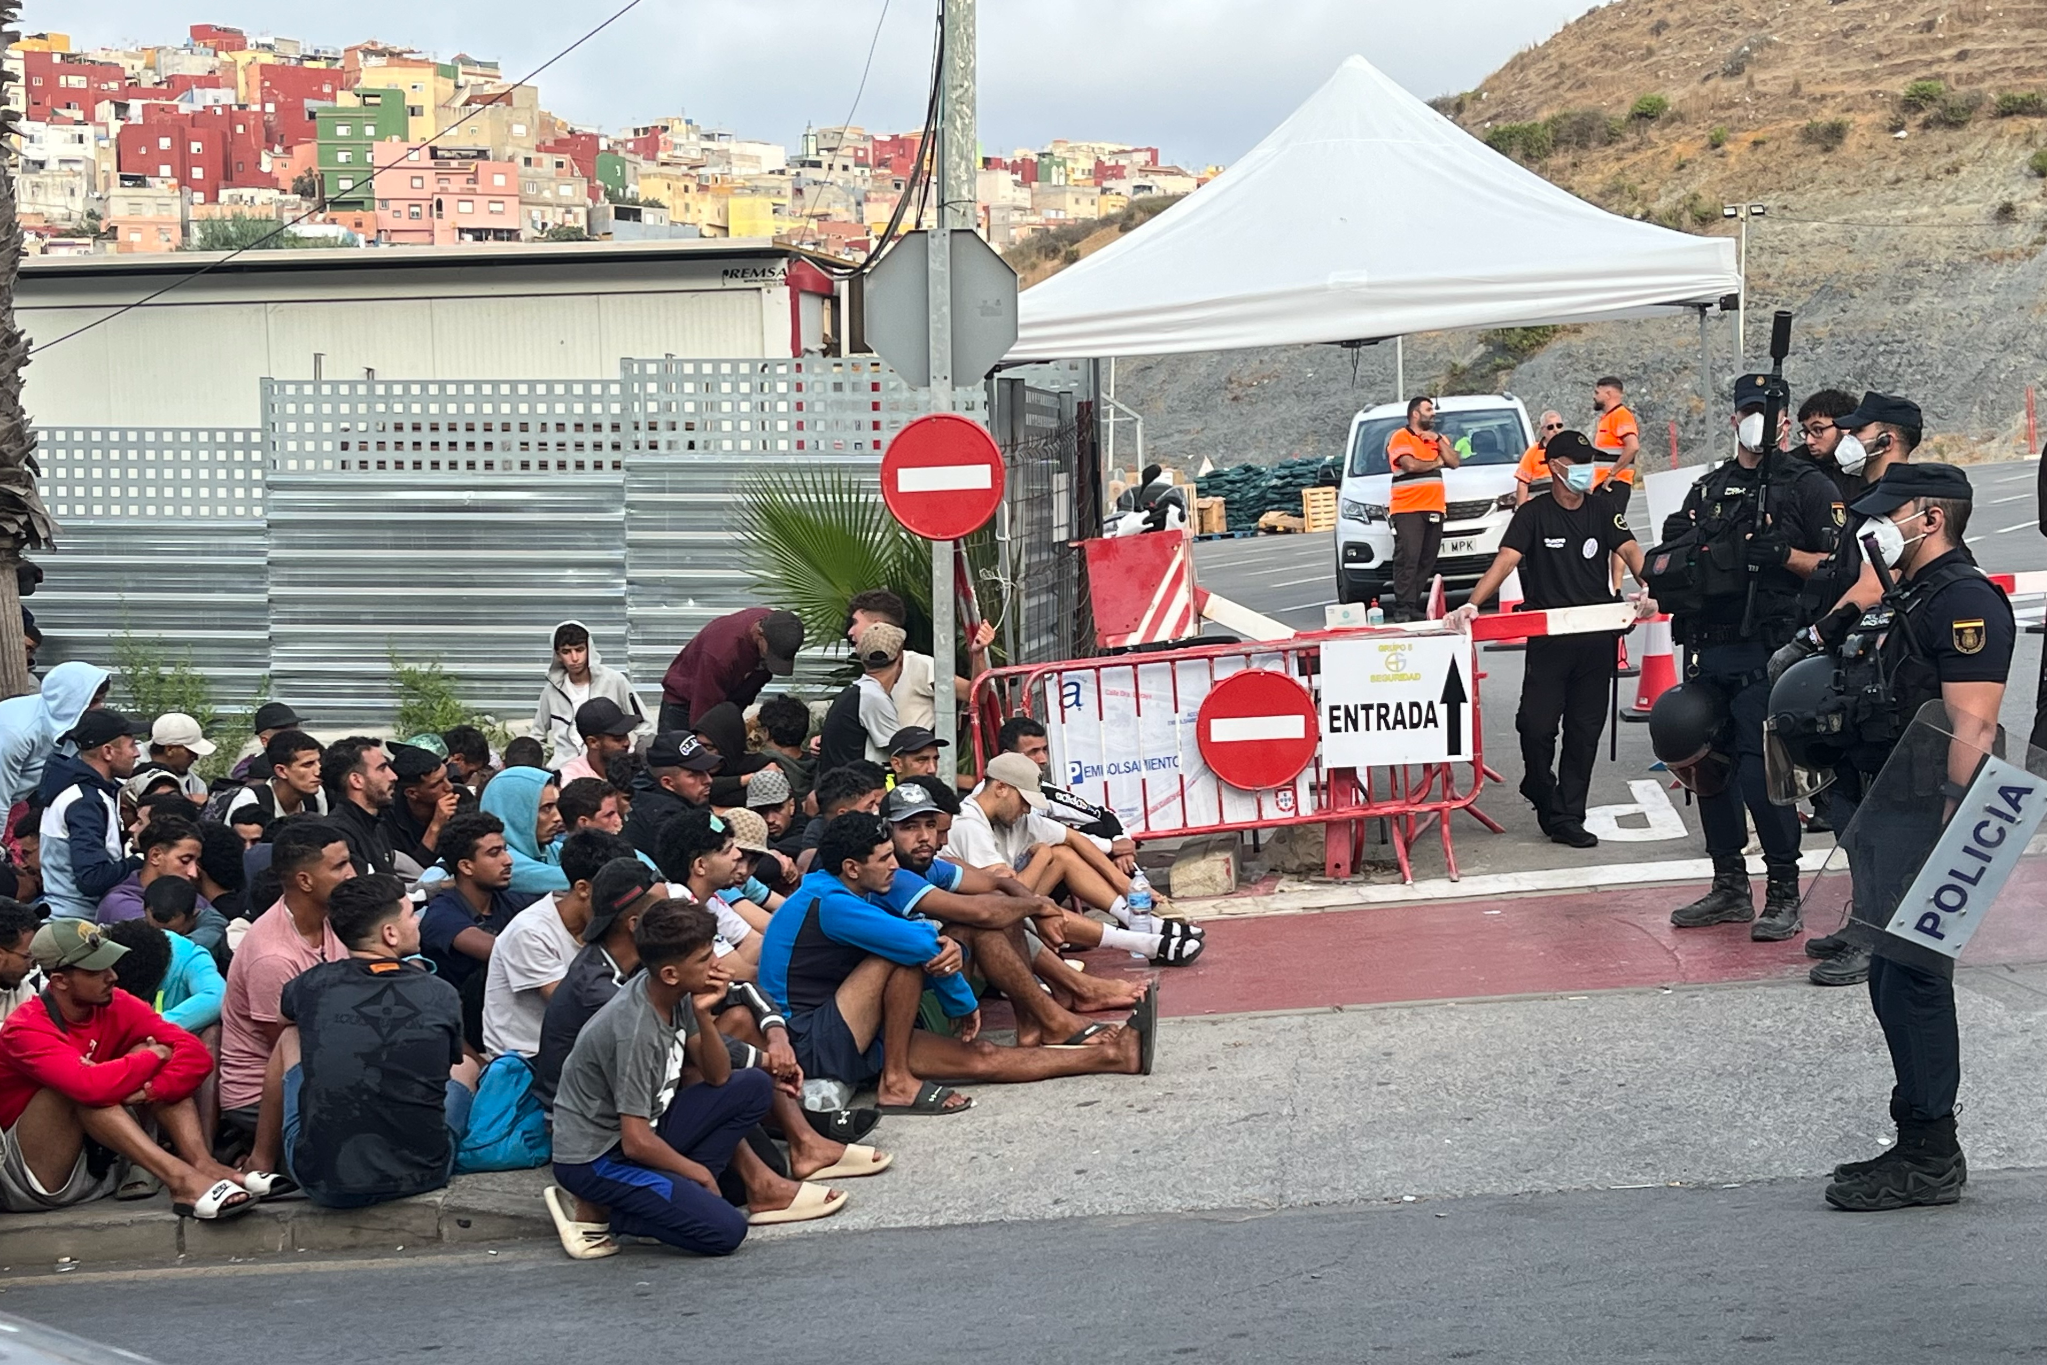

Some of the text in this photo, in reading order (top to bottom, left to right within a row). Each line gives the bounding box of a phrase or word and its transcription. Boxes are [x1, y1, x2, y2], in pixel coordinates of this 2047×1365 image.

[1451, 541, 1473, 552] MPK
[1370, 672, 1421, 683] SEGURIDAD
[1329, 700, 1439, 733] ENTRADA
[1914, 785, 2034, 940] POLICIA
